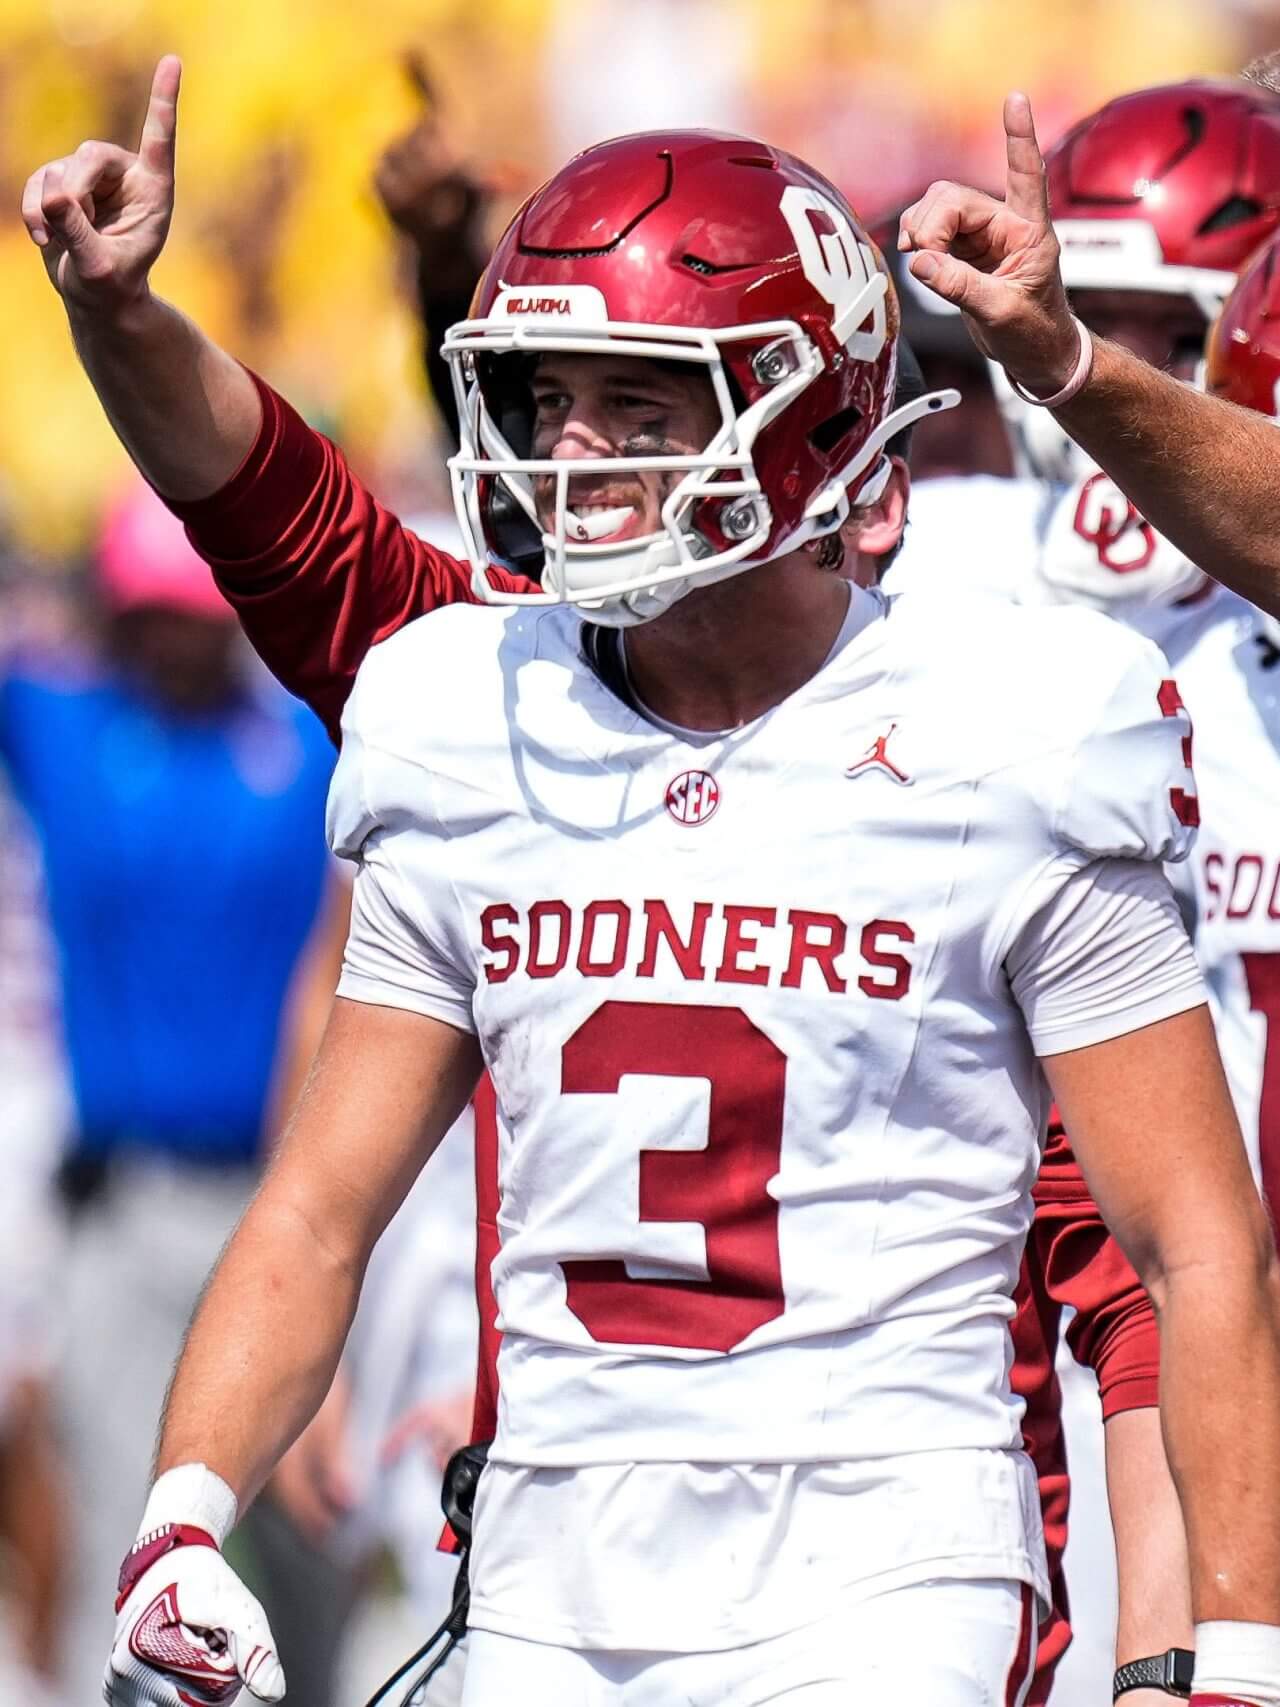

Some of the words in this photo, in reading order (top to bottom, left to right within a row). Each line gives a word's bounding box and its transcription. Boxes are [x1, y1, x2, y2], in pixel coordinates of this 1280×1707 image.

[664, 769, 720, 825] SEC
[480, 899, 915, 1001] SOONERS
[558, 1000, 788, 1354] 3
